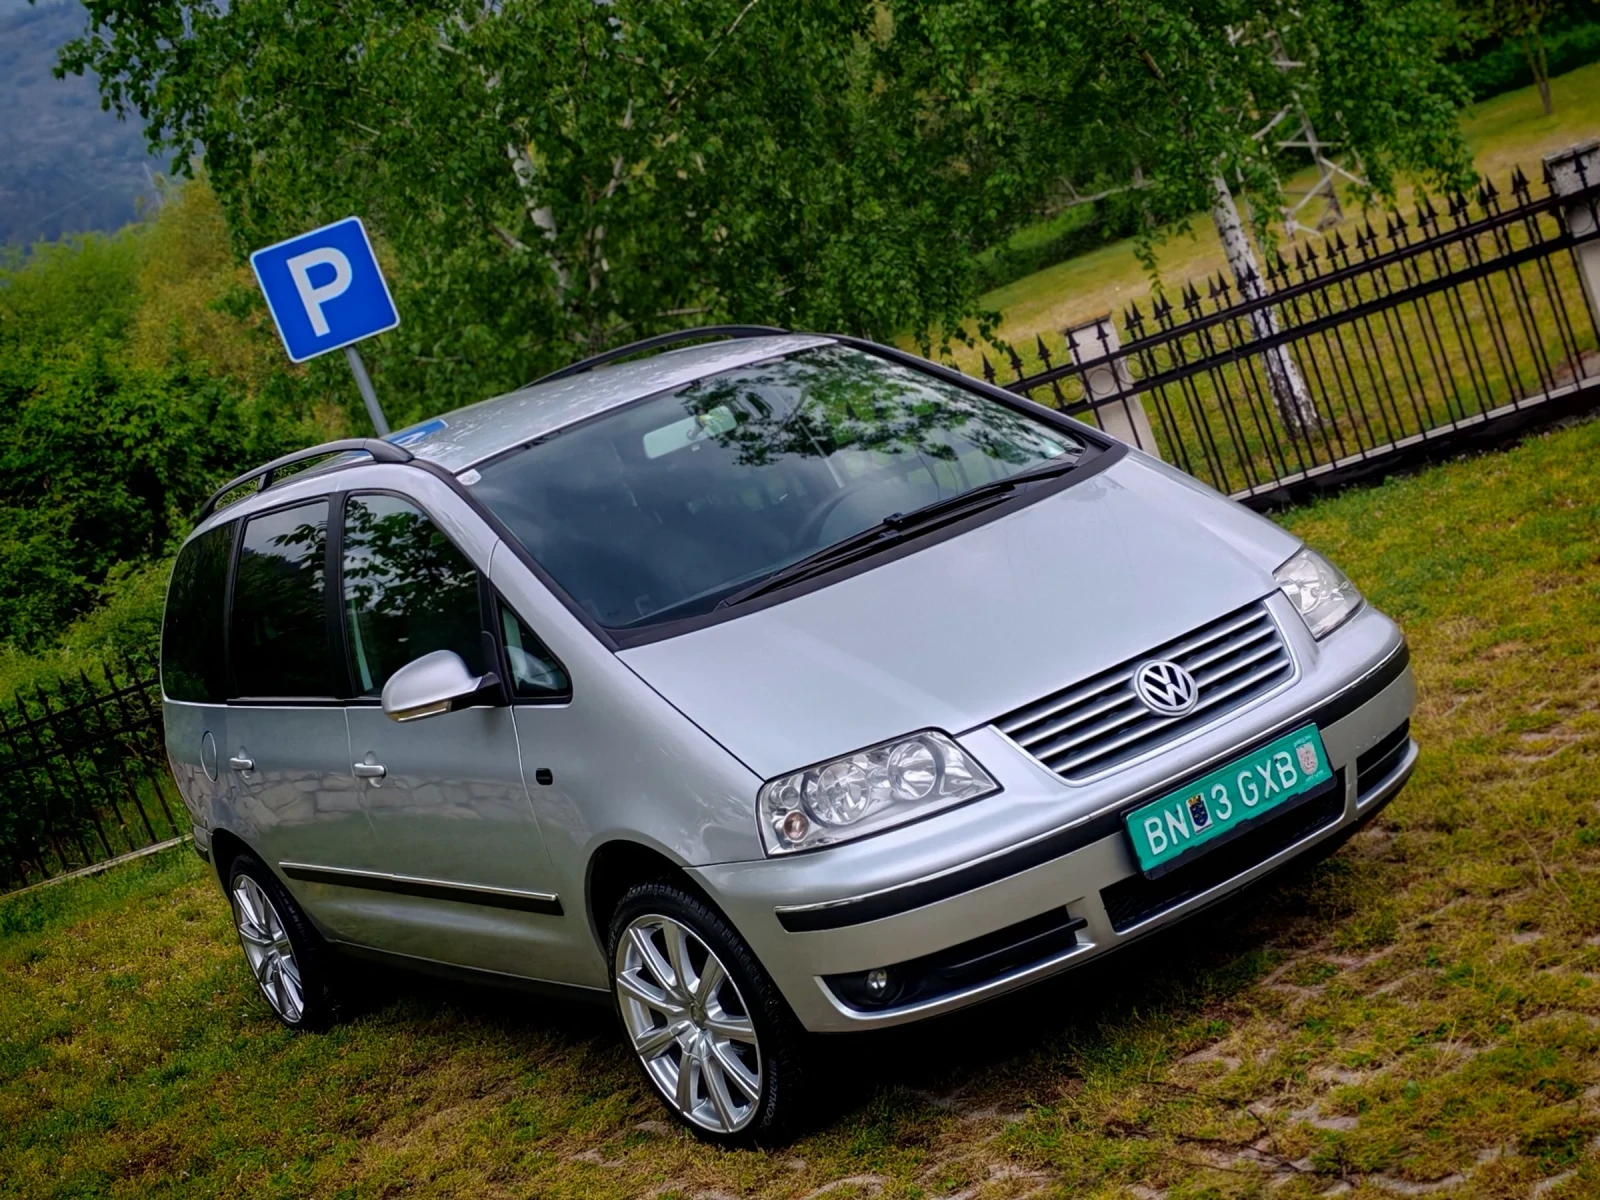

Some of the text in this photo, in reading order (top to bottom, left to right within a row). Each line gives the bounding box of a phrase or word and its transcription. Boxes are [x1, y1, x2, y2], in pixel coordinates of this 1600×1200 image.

[286, 247, 353, 338] P
[1139, 661, 1194, 710] VW
[1143, 751, 1298, 855] BN 3 GXB
